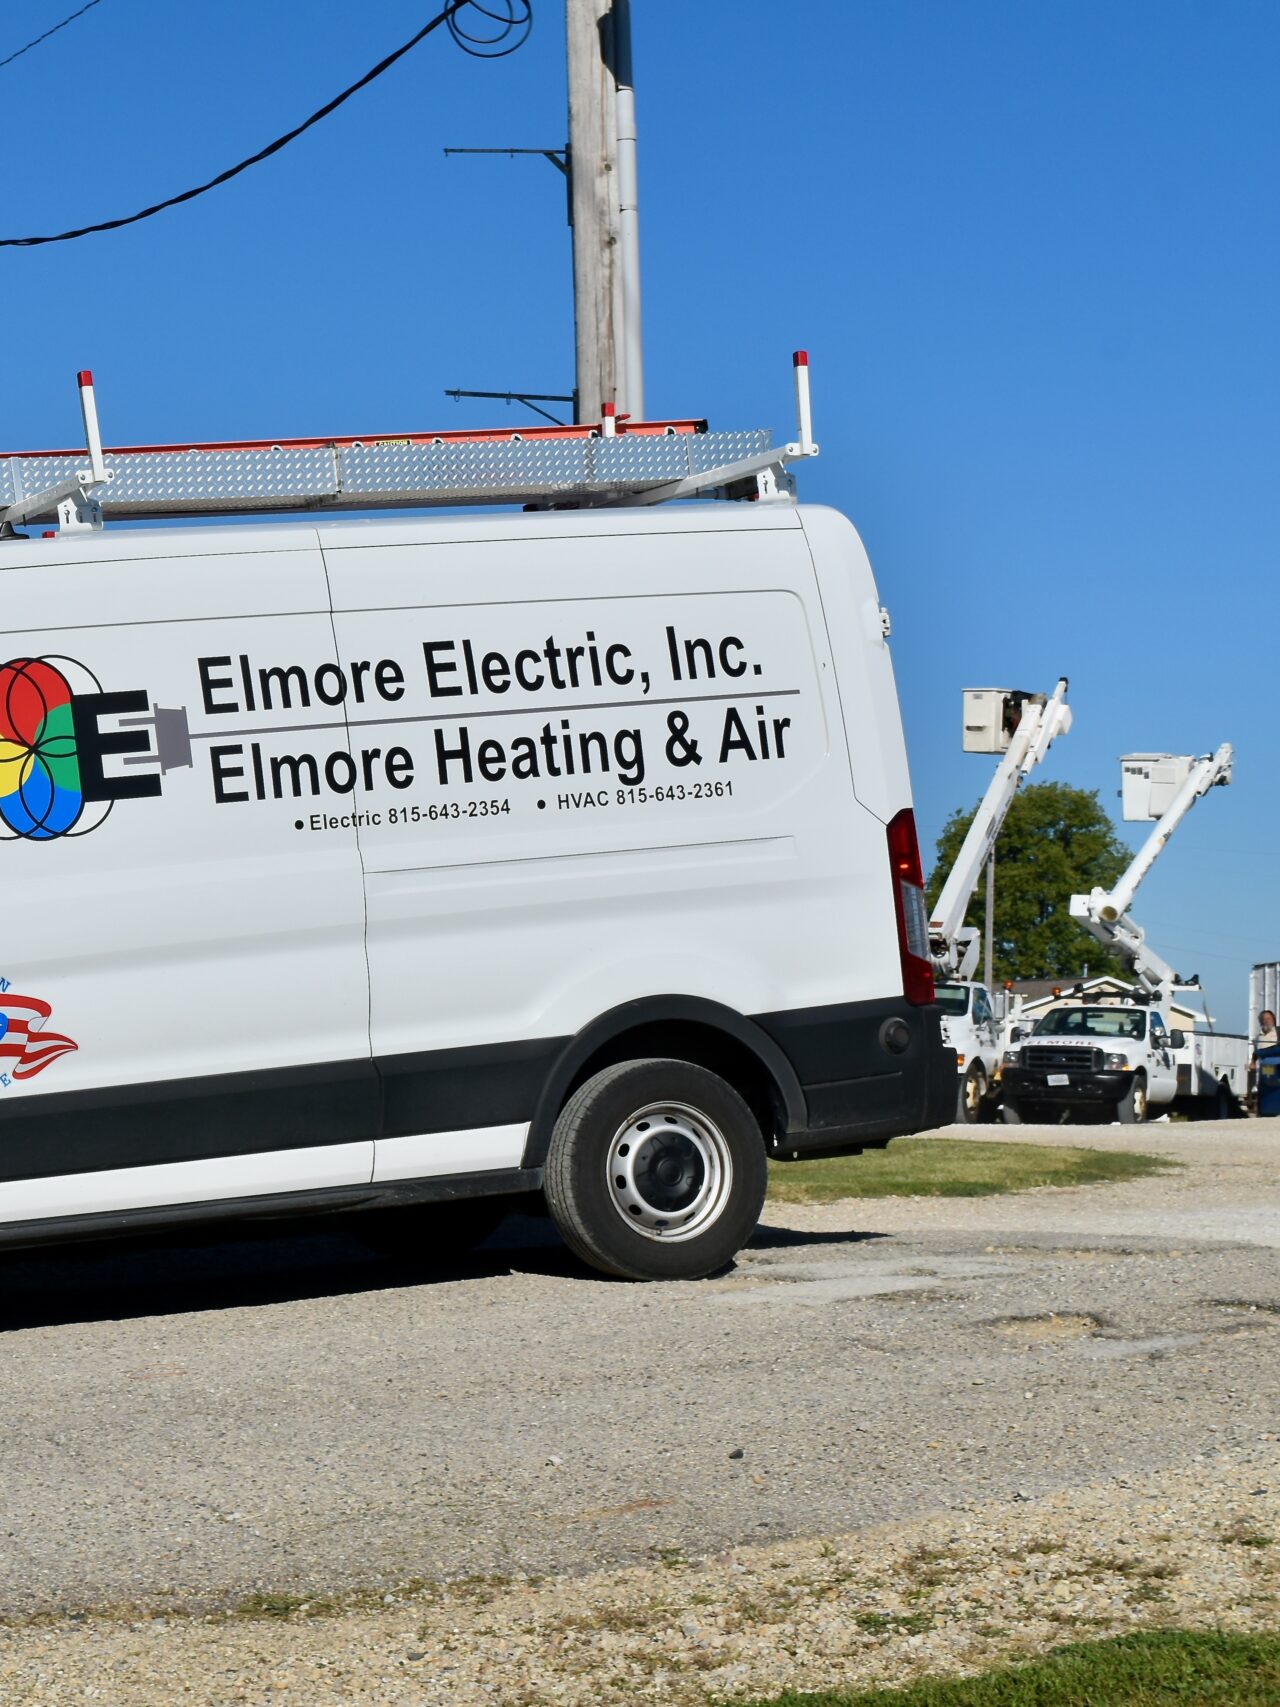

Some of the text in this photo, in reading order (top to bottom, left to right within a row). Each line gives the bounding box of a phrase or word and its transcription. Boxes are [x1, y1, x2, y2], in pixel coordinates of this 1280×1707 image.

[197, 626, 762, 715] Elmore Electric, Inc.
[210, 705, 792, 804] Elmore Heating & Air
[309, 781, 734, 831] Electric 815-643-2354 HVAC 815-643-2361
